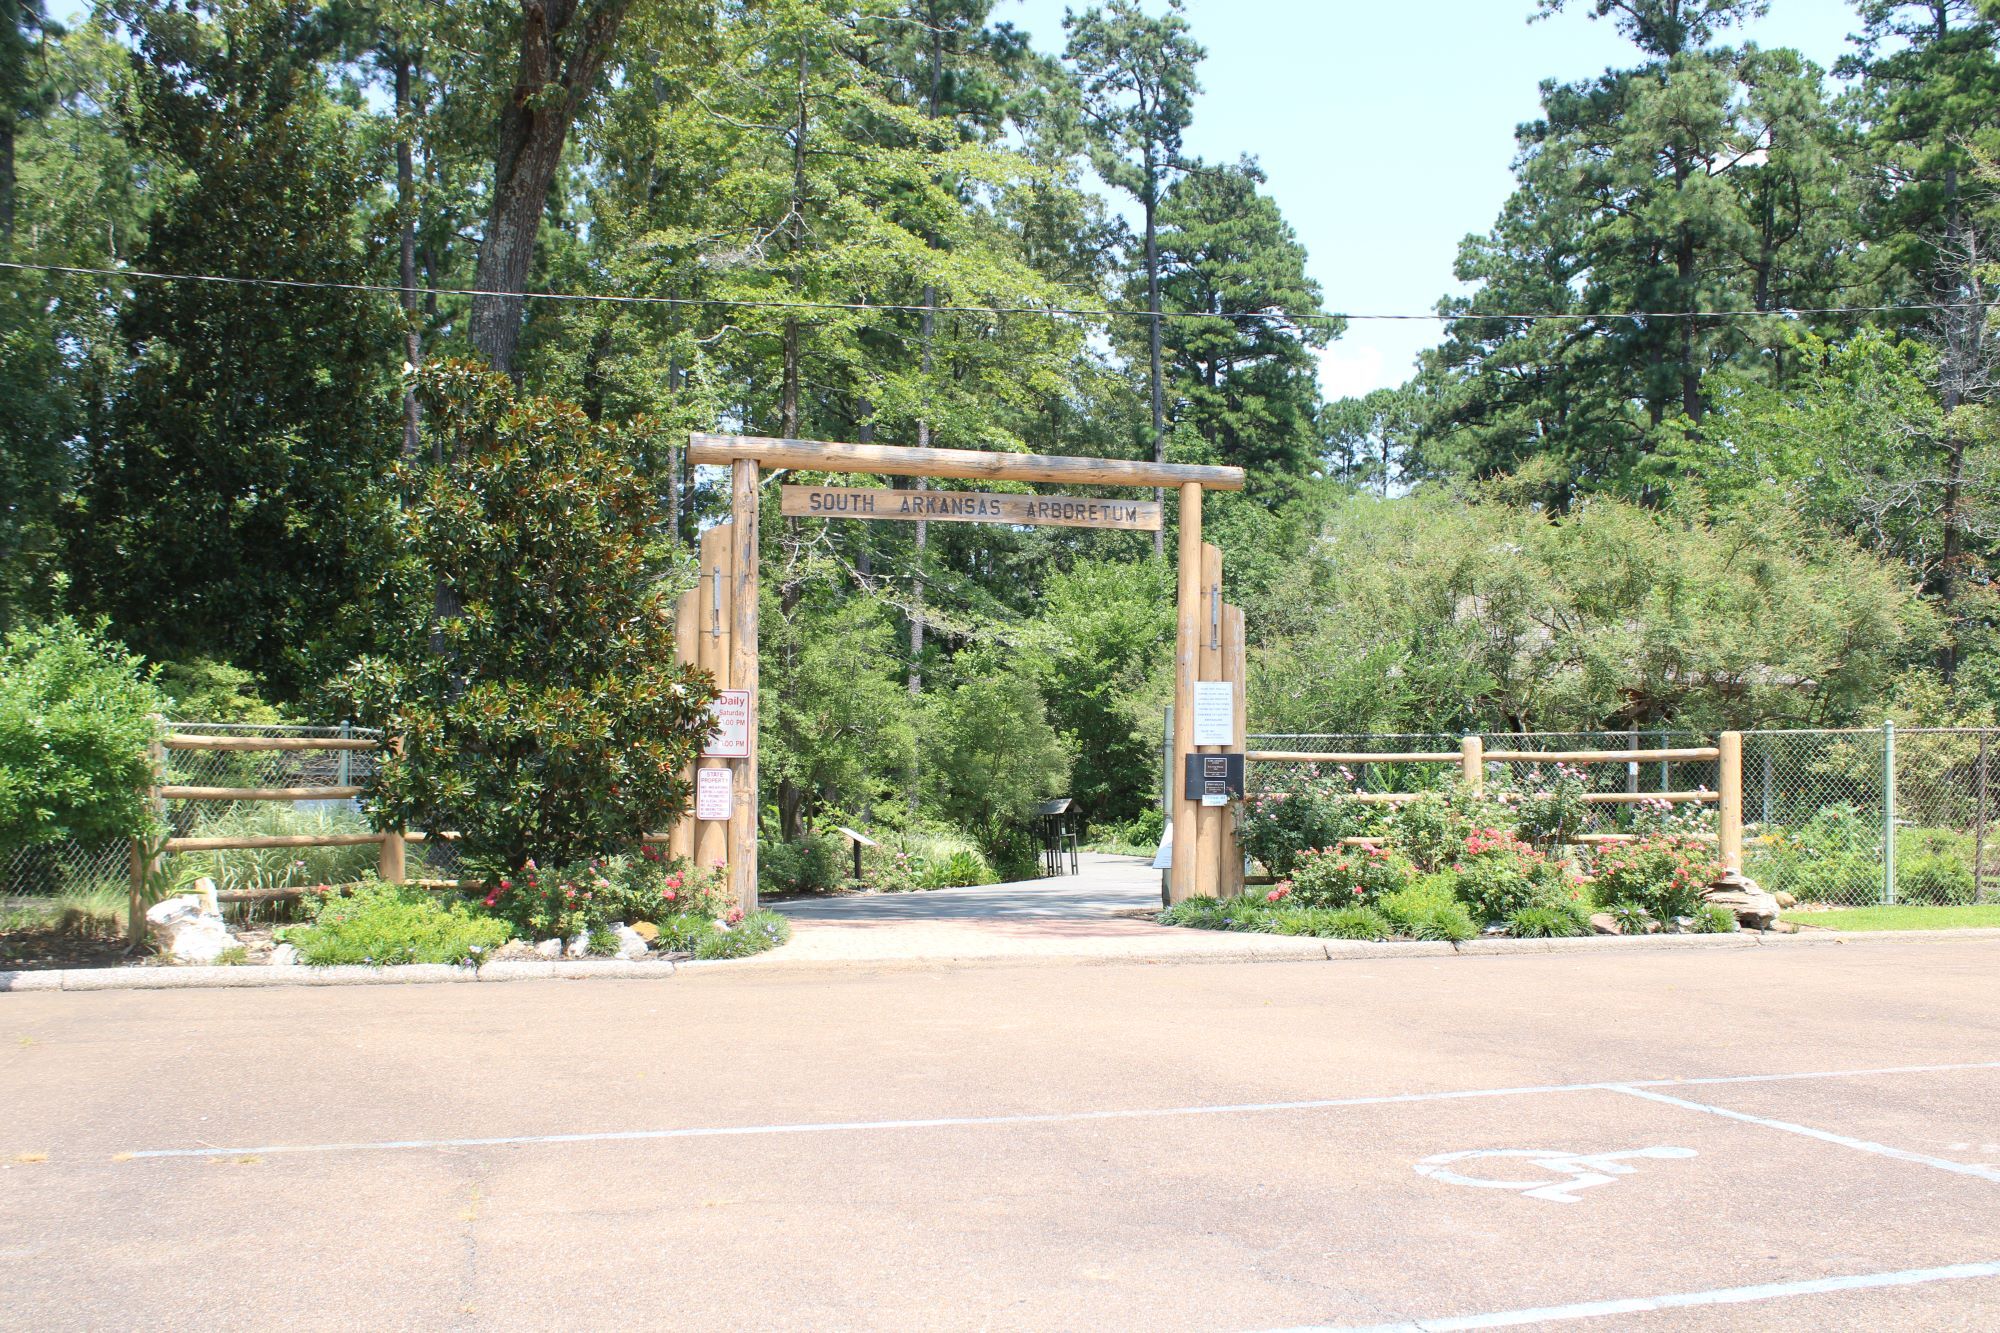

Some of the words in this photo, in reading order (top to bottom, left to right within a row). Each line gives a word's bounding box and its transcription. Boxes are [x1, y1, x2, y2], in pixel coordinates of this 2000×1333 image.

[809, 492, 875, 512] SOUTH
[900, 496, 1001, 516] ARKANSAS
[1026, 501, 1137, 523] ARBORETUM
[720, 696, 745, 707] Daily
[719, 710, 745, 718] Saturday
